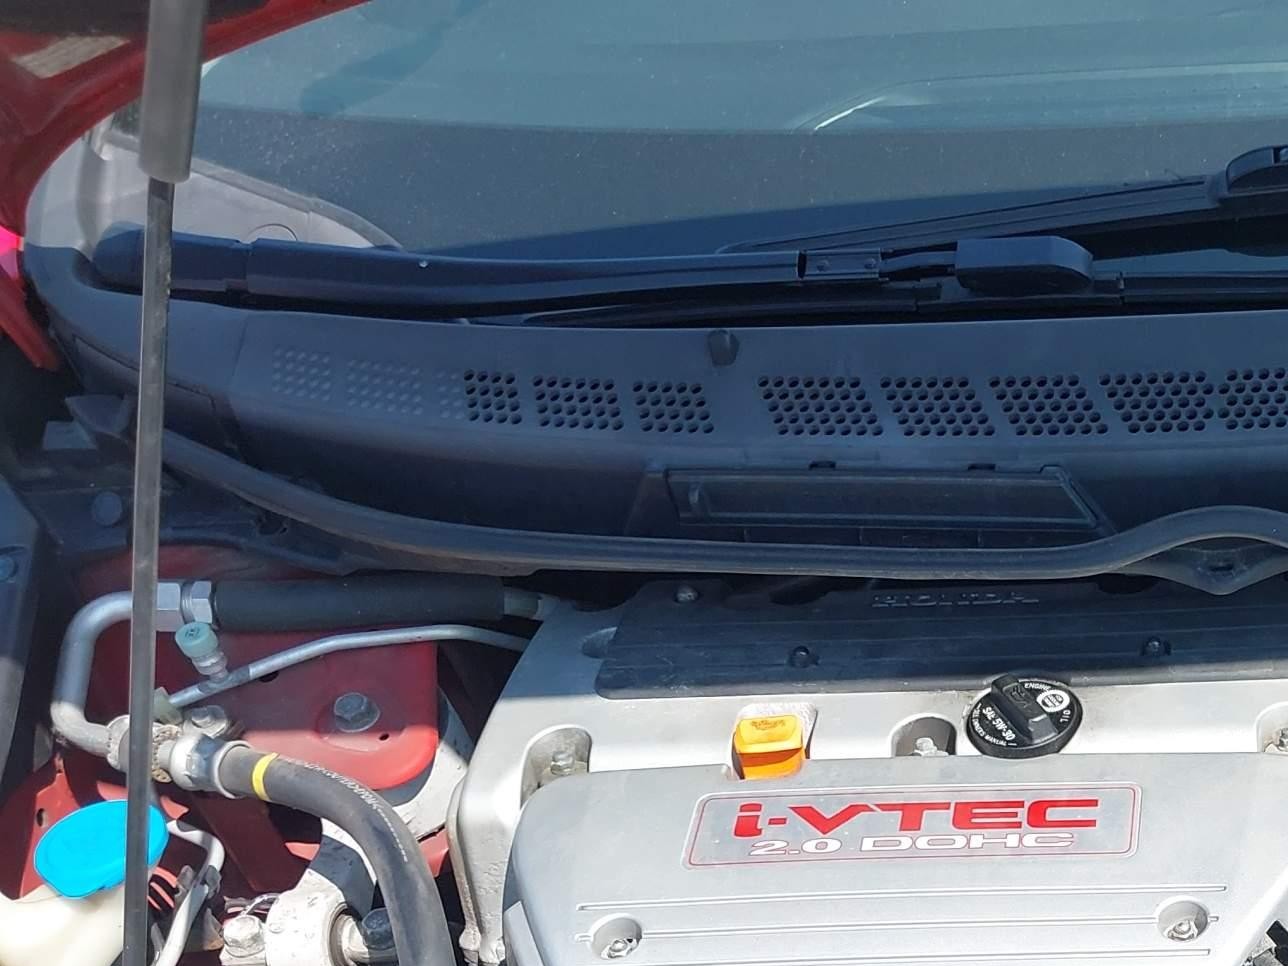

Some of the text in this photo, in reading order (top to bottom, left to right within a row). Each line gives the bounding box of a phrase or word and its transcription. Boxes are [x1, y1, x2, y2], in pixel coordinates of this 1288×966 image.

[1059, 708, 1072, 723] OIL
[992, 718, 1016, 741] 5W-30
[732, 798, 1099, 838] i-VTEC
[748, 832, 1074, 856] 2.0 DOHC
